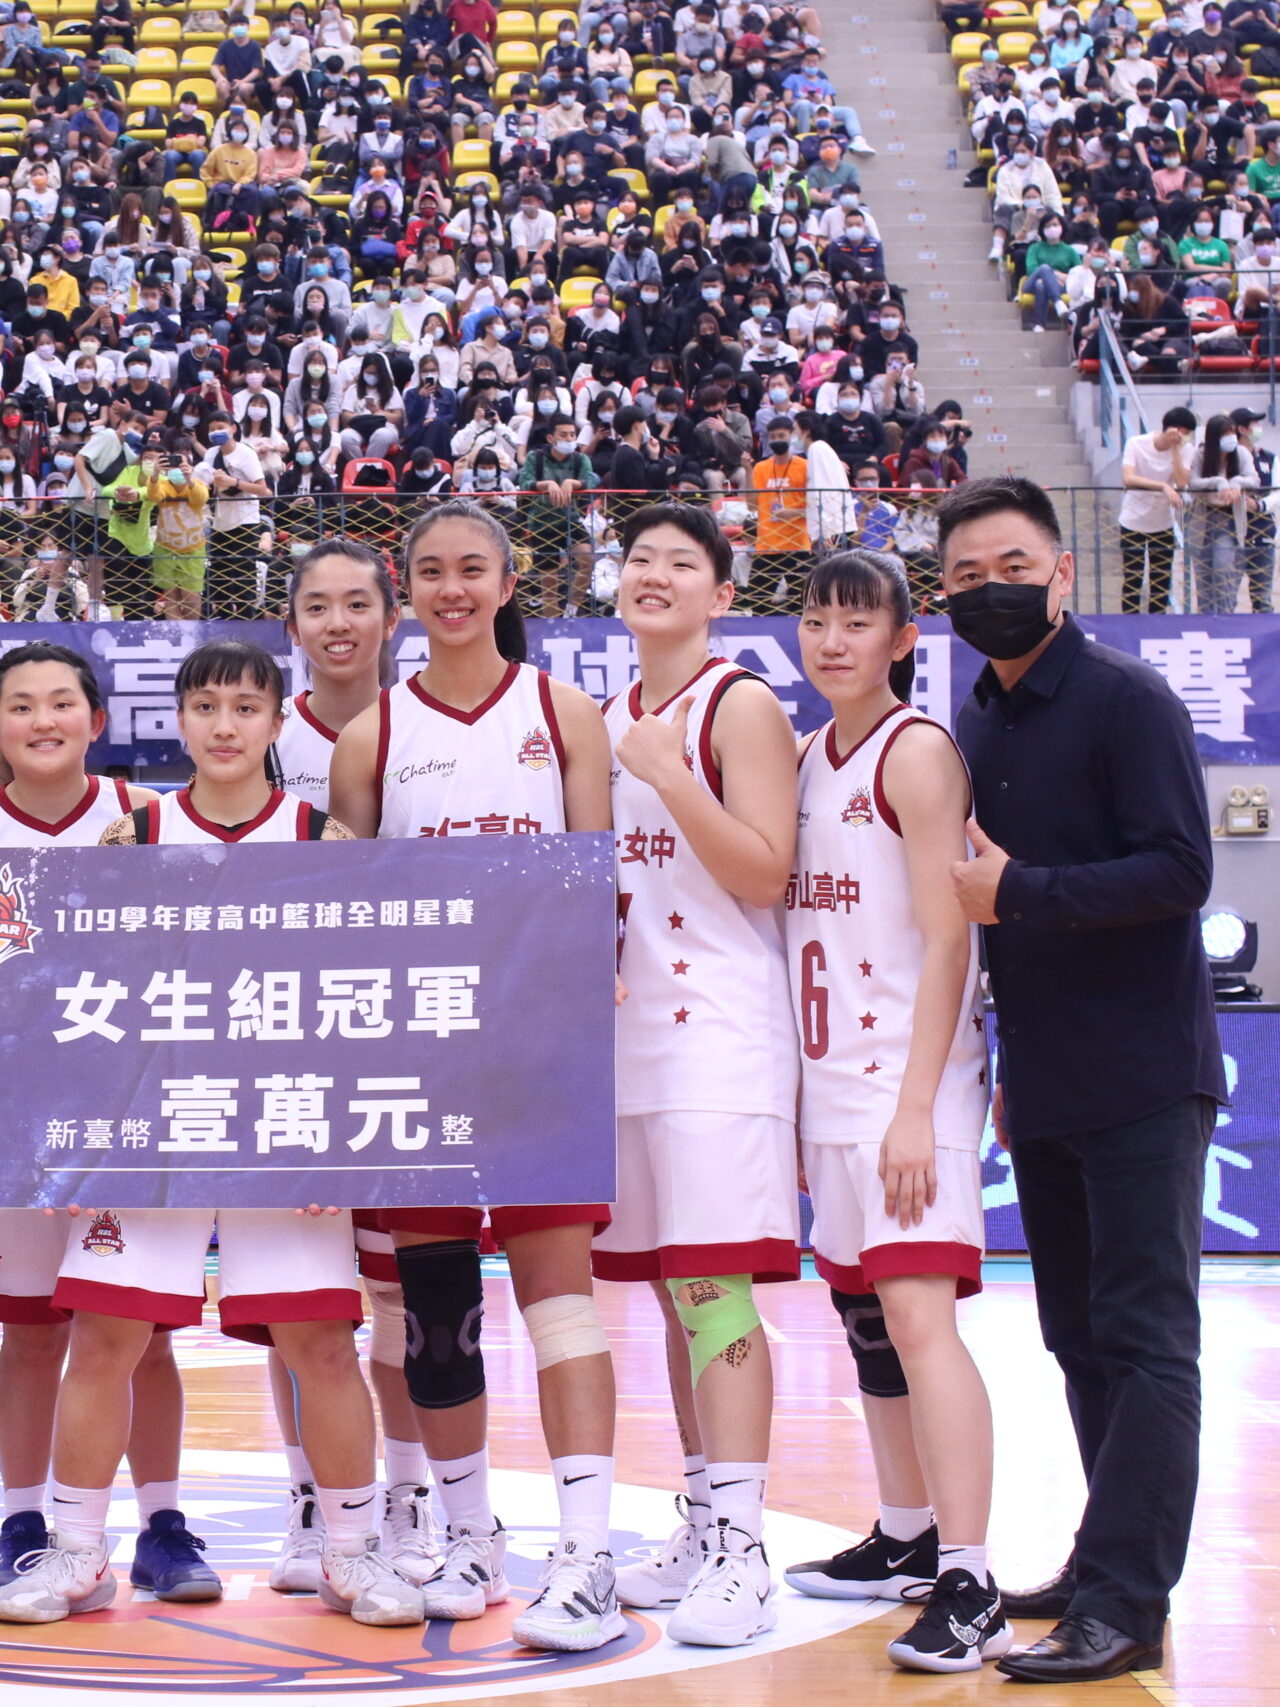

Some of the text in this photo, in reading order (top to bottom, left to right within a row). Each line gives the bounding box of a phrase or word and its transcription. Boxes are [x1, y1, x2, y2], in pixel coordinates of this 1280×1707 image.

[400, 758, 457, 784] Chatime
[54, 897, 475, 934] 109學年度高中籃球全明星賽
[52, 965, 481, 1044] 女生組冠軍
[800, 940, 829, 1060] 6
